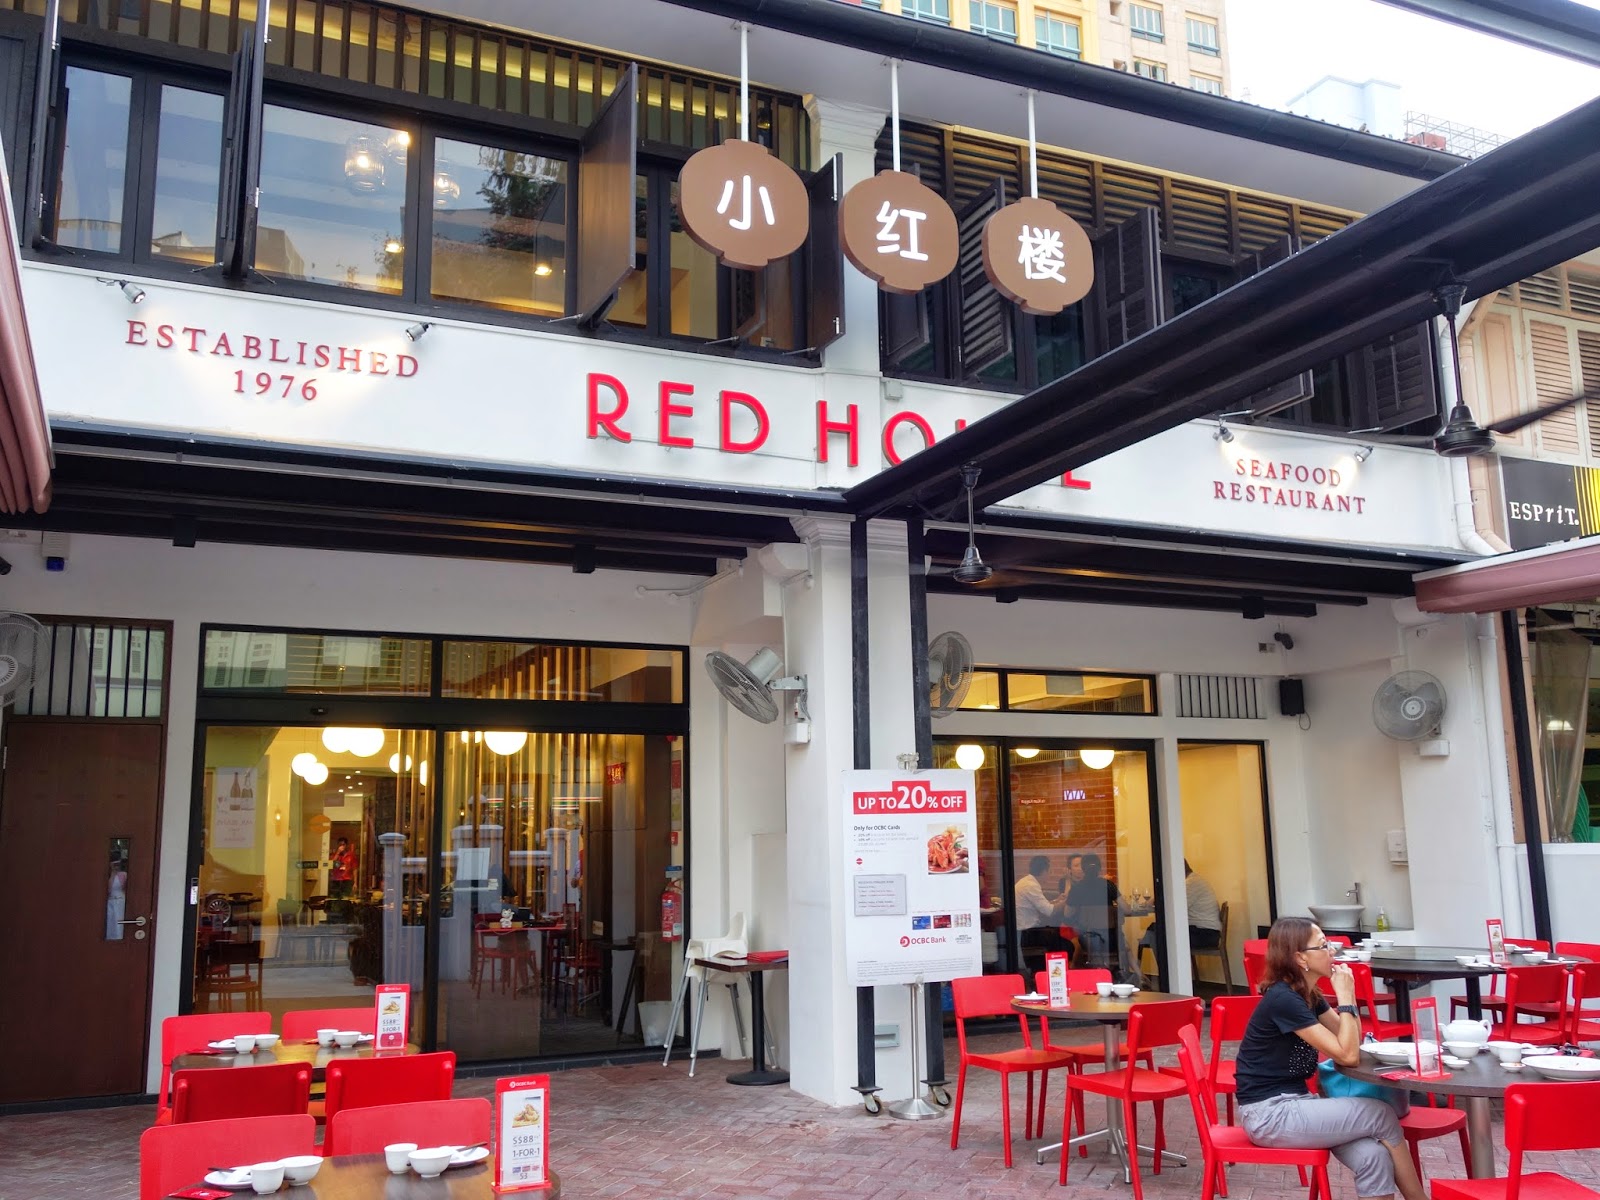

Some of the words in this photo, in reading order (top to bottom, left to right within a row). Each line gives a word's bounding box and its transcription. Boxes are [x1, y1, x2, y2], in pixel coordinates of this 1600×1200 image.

[716, 174, 776, 231] 小
[875, 200, 930, 262] 红
[1017, 224, 1067, 284] 楼
[125, 320, 419, 378] ESTABLISHED
[233, 369, 318, 401] 1976
[586, 372, 771, 454] RED
[1235, 458, 1342, 487] SEAFOOD
[1213, 480, 1367, 515] RESTAURANT
[857, 797, 876, 810] UP
[878, 796, 897, 810] TO
[897, 785, 939, 809] 20%
[941, 796, 963, 808] OFF
[911, 937, 930, 945] OCBC
[930, 935, 947, 944] Bank
[512, 1147, 540, 1158] 1-FOR-1
